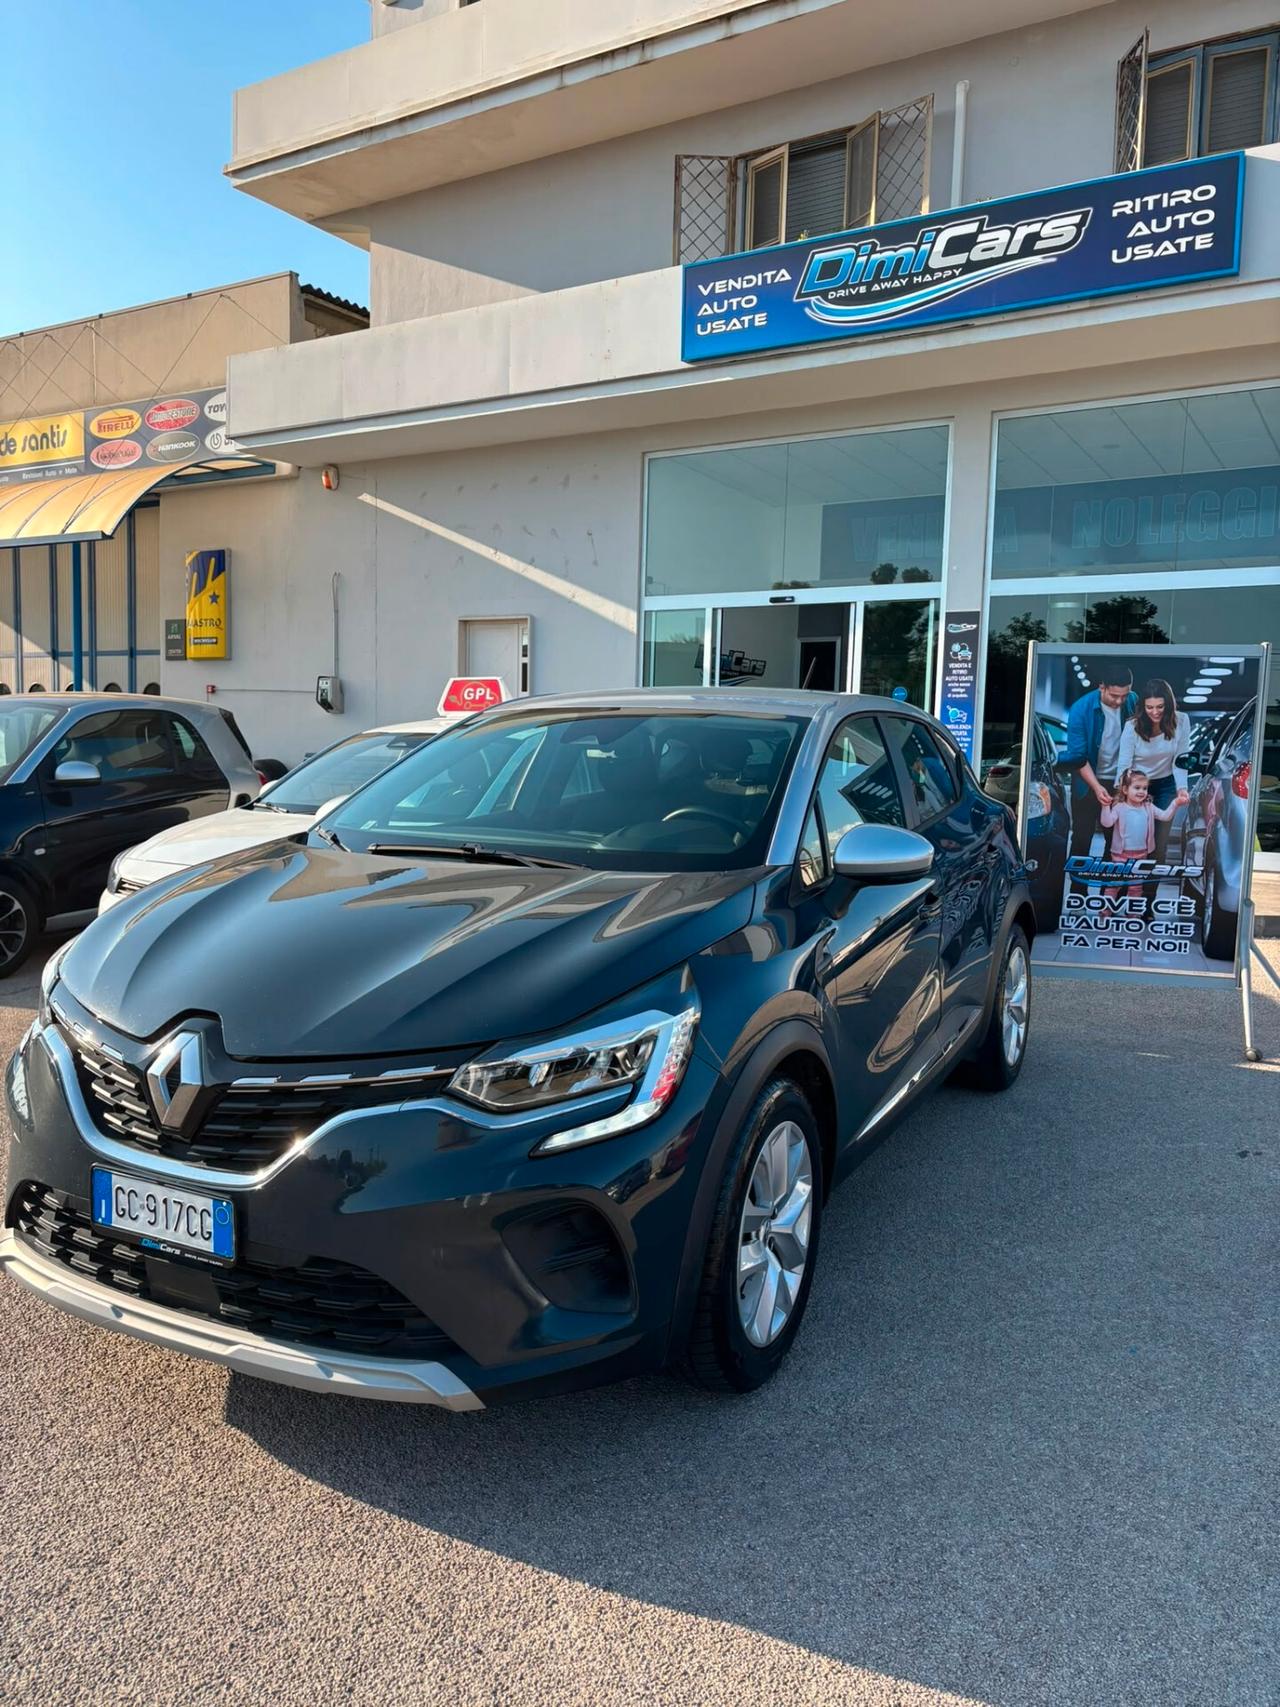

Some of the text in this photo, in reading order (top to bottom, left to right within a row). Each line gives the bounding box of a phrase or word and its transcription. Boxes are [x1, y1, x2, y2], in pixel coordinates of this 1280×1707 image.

[1112, 184, 1217, 217] RITIRO
[1126, 208, 1216, 238] AUTO
[800, 212, 1084, 294] DimiCars
[1111, 232, 1215, 263] USATE
[698, 268, 792, 296] VENDITA
[828, 267, 962, 299] DRIVE AWAY HAPPY
[697, 295, 758, 317] AUTO
[696, 312, 768, 336] USATE
[207, 402, 227, 415] TOY
[97, 414, 135, 433] PIRELLI
[21, 424, 67, 453] santis
[1071, 485, 1280, 549] NOLEGGI
[463, 687, 495, 701] GPL
[1064, 855, 1205, 877] DimiCars
[1065, 894, 1196, 916] DOVE C'È
[1060, 915, 1195, 936] L'AUTO CHE
[1062, 934, 1189, 954] FA PER NOI!
[140, 1238, 181, 1256] DimiCars
